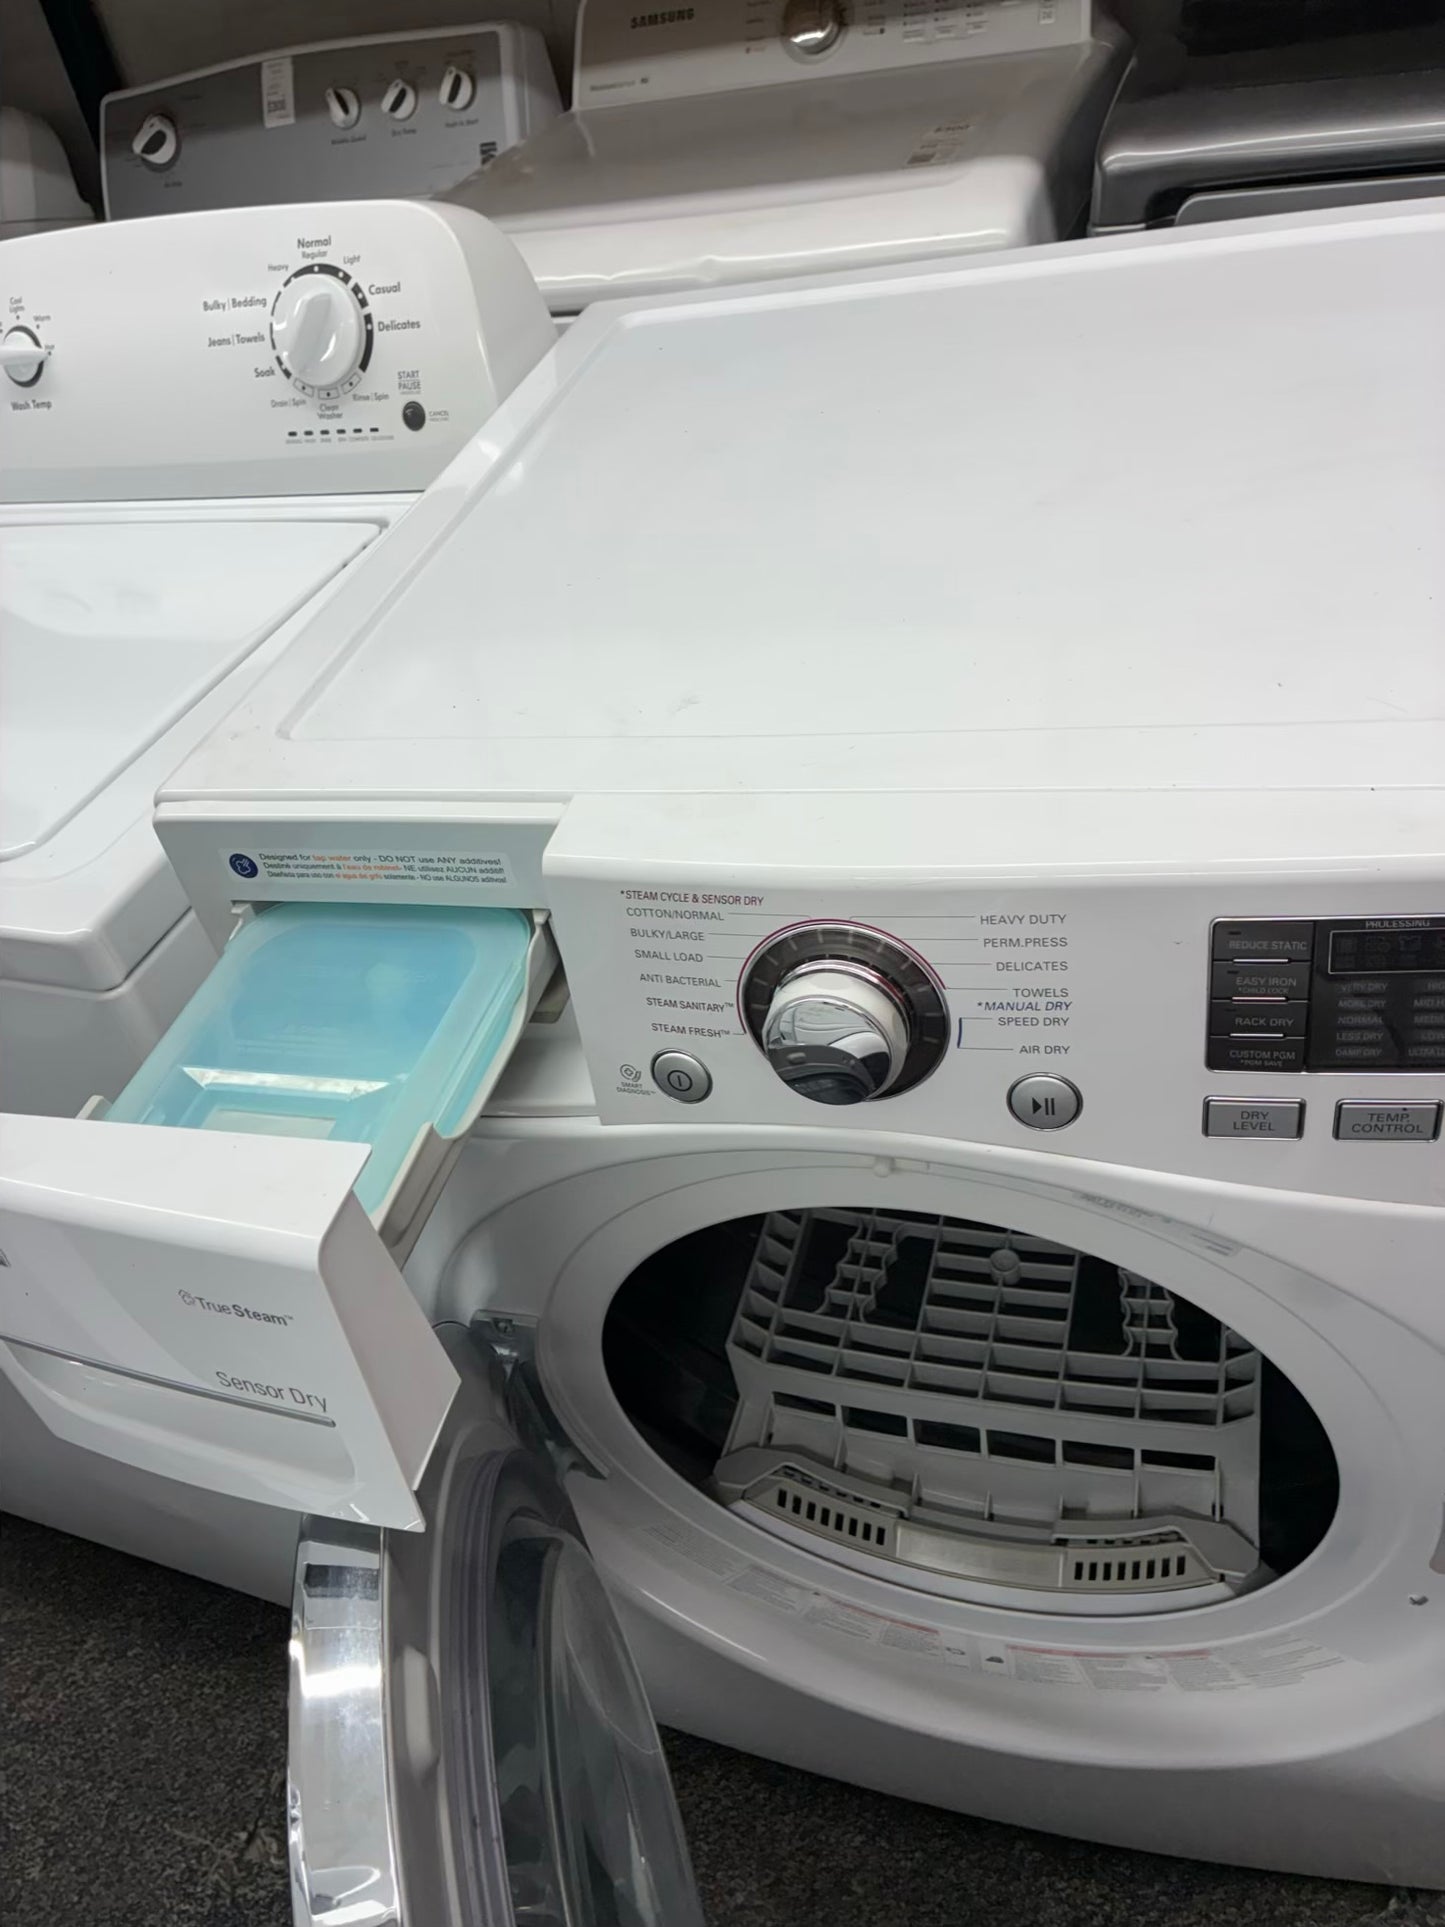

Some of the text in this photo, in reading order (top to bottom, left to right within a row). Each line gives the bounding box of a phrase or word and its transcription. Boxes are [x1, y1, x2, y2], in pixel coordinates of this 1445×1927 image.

[630, 8, 694, 29] SAMSUNG
[297, 235, 332, 249] Normal
[301, 250, 328, 260] Regular
[343, 254, 361, 266] Light
[368, 281, 401, 295] Casual
[378, 320, 421, 332] Delicates
[254, 366, 275, 378] Soak
[397, 370, 419, 379] START
[398, 381, 421, 390] PAUSE
[319, 403, 339, 412] Clean
[259, 853, 297, 862] Designed
[353, 855, 371, 863] only
[378, 855, 394, 863] DO
[395, 855, 416, 863] NOT
[437, 856, 456, 864] ANY
[446, 866, 477, 874] AUCUN
[660, 892, 689, 903] CYCLE
[692, 893, 699, 903] &
[701, 894, 741, 905] SENSOR
[744, 896, 764, 906] DRY
[626, 907, 725, 921] COTTON/NORMAL
[980, 914, 1066, 925] HEAVY DUTY
[630, 928, 705, 941] BULKY/LARGE
[983, 937, 1068, 948] PERM.PRESS
[1229, 940, 1308, 951] REDUCE STATIC
[634, 949, 704, 963] SMALL LOAD
[996, 961, 1069, 972] DELICATES
[639, 973, 722, 988] ANTI BACTERIAL
[1236, 976, 1297, 987] EASY IRON
[1012, 988, 1069, 998] TOWELS
[646, 997, 678, 1008] STEAM
[1045, 1001, 1072, 1012] DRY
[997, 1017, 1070, 1027] SPEED DRY
[1235, 1017, 1294, 1027] RACK DRY
[1337, 1016, 1383, 1025] NORMAL
[651, 1022, 687, 1034] STEAM
[1336, 1032, 1384, 1041] LESS DRY
[1019, 1045, 1071, 1055] AIR DRY
[1229, 1049, 1296, 1060] CUSTOM PGM
[1335, 1048, 1382, 1057] DAMP DRY
[620, 1081, 643, 1089] SMART
[1240, 1110, 1269, 1121] DRY
[1232, 1121, 1275, 1132] LEVEL
[1351, 1122, 1424, 1134] CONTROL
[215, 1370, 328, 1413] Sensor Dry
